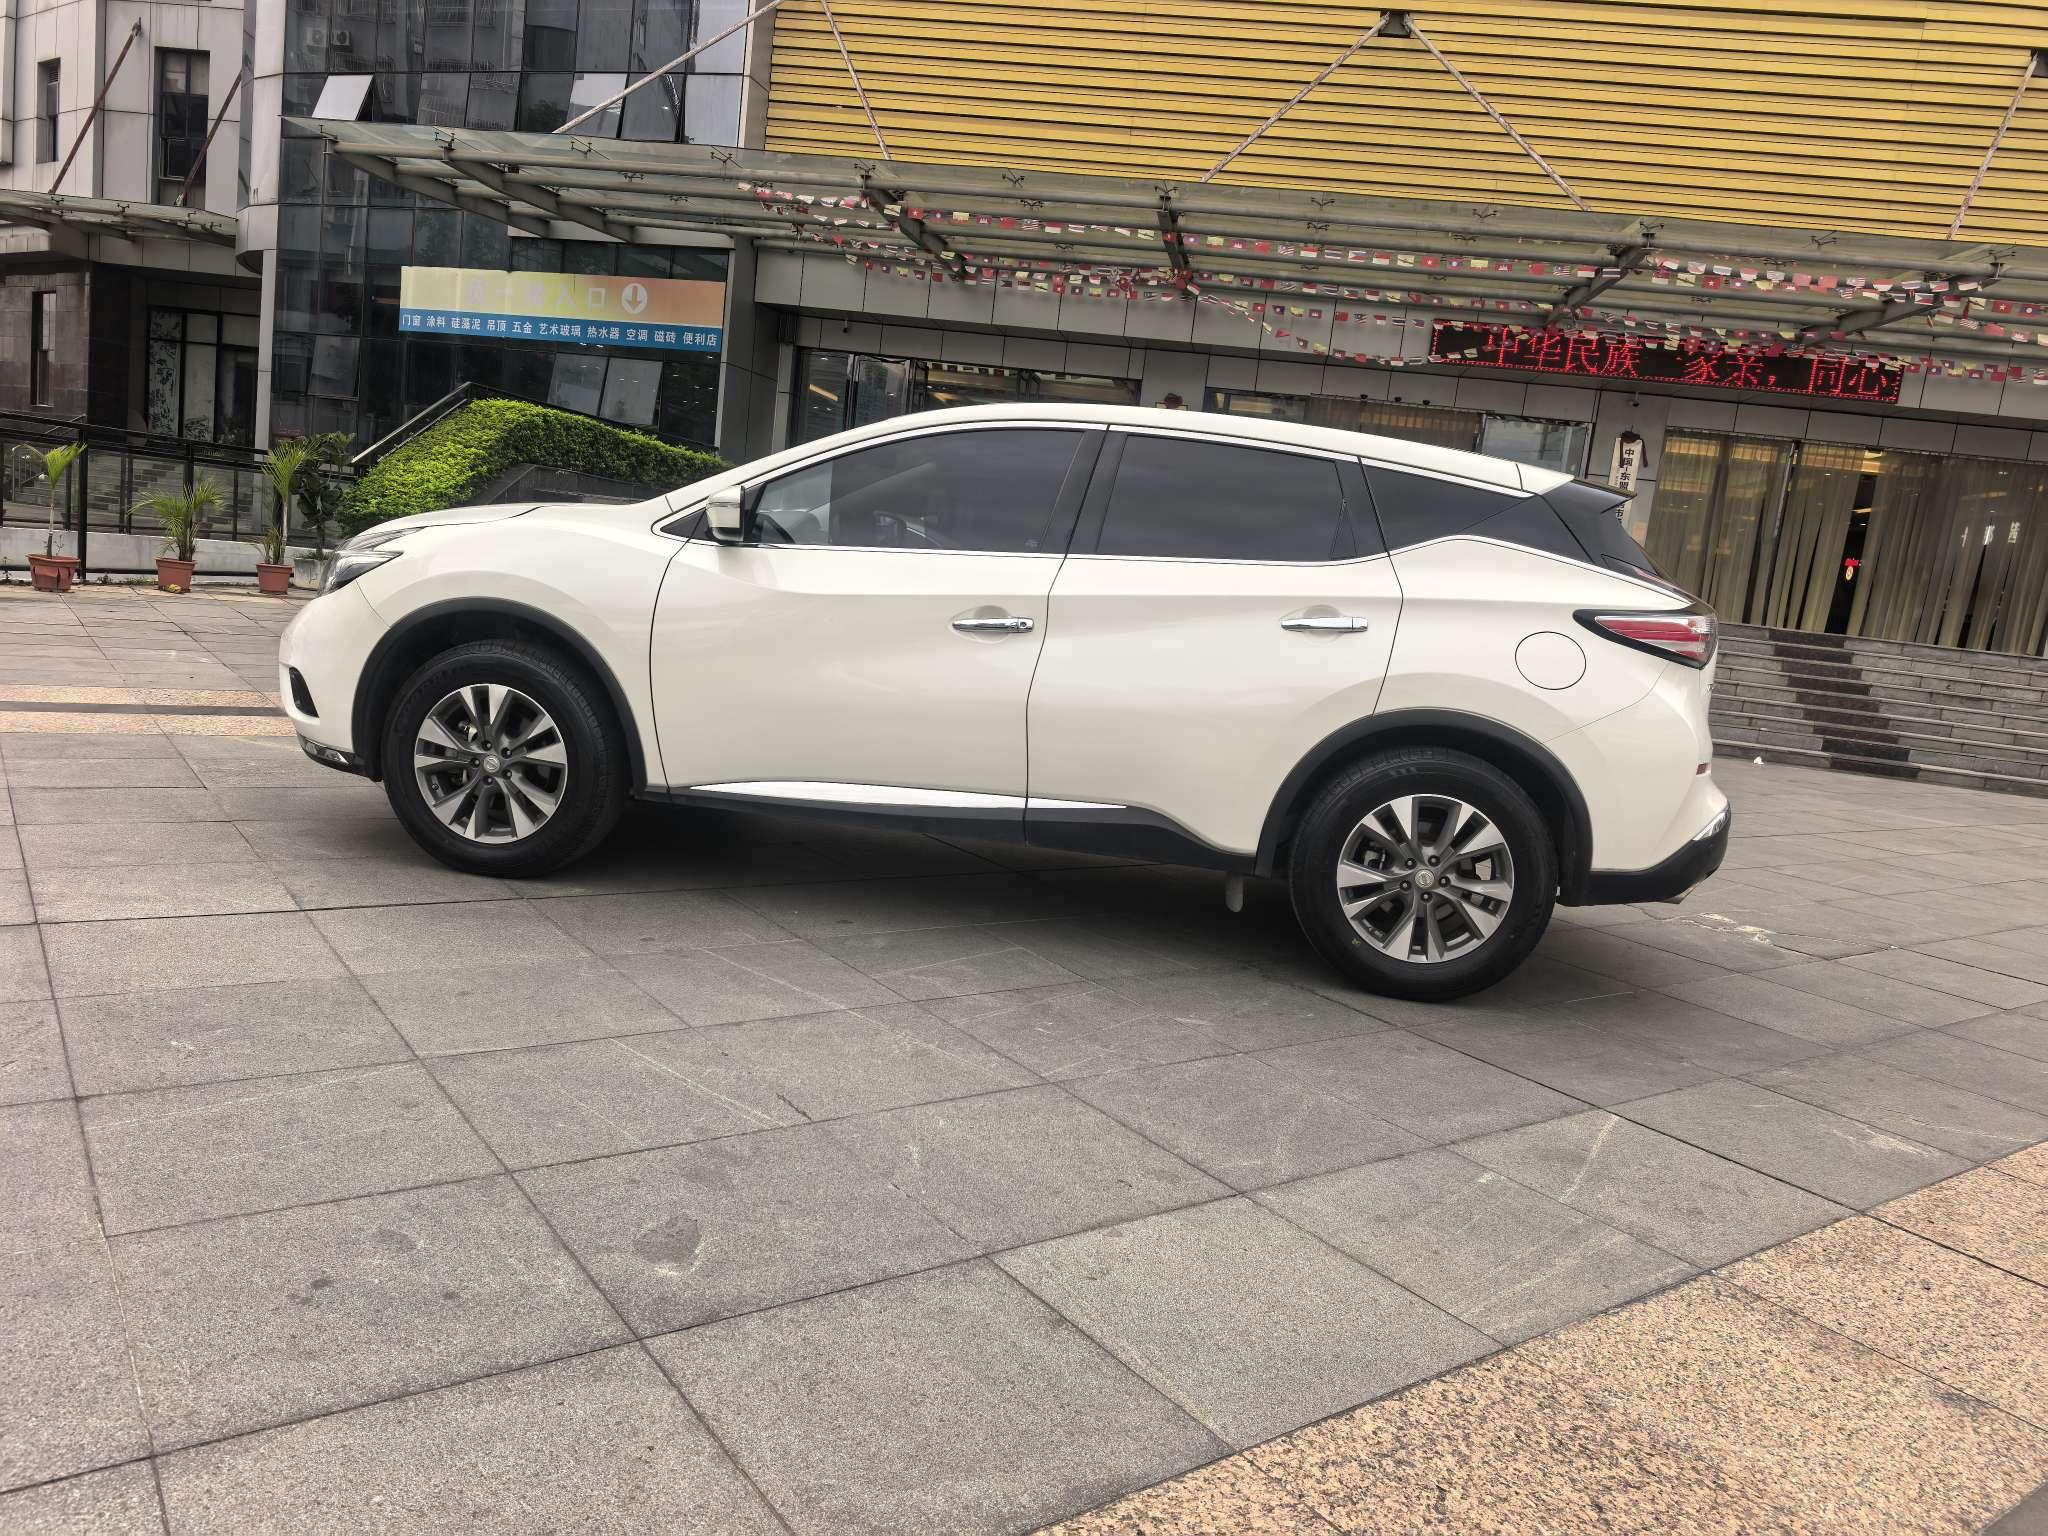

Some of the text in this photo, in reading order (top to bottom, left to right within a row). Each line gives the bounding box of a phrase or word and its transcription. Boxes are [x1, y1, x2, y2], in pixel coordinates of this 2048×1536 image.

[402, 314, 718, 347] 门窗 涂料 硅藻泥 吊顶 五金 艺术玻璃 热水器 空调 磁砖 便利店
